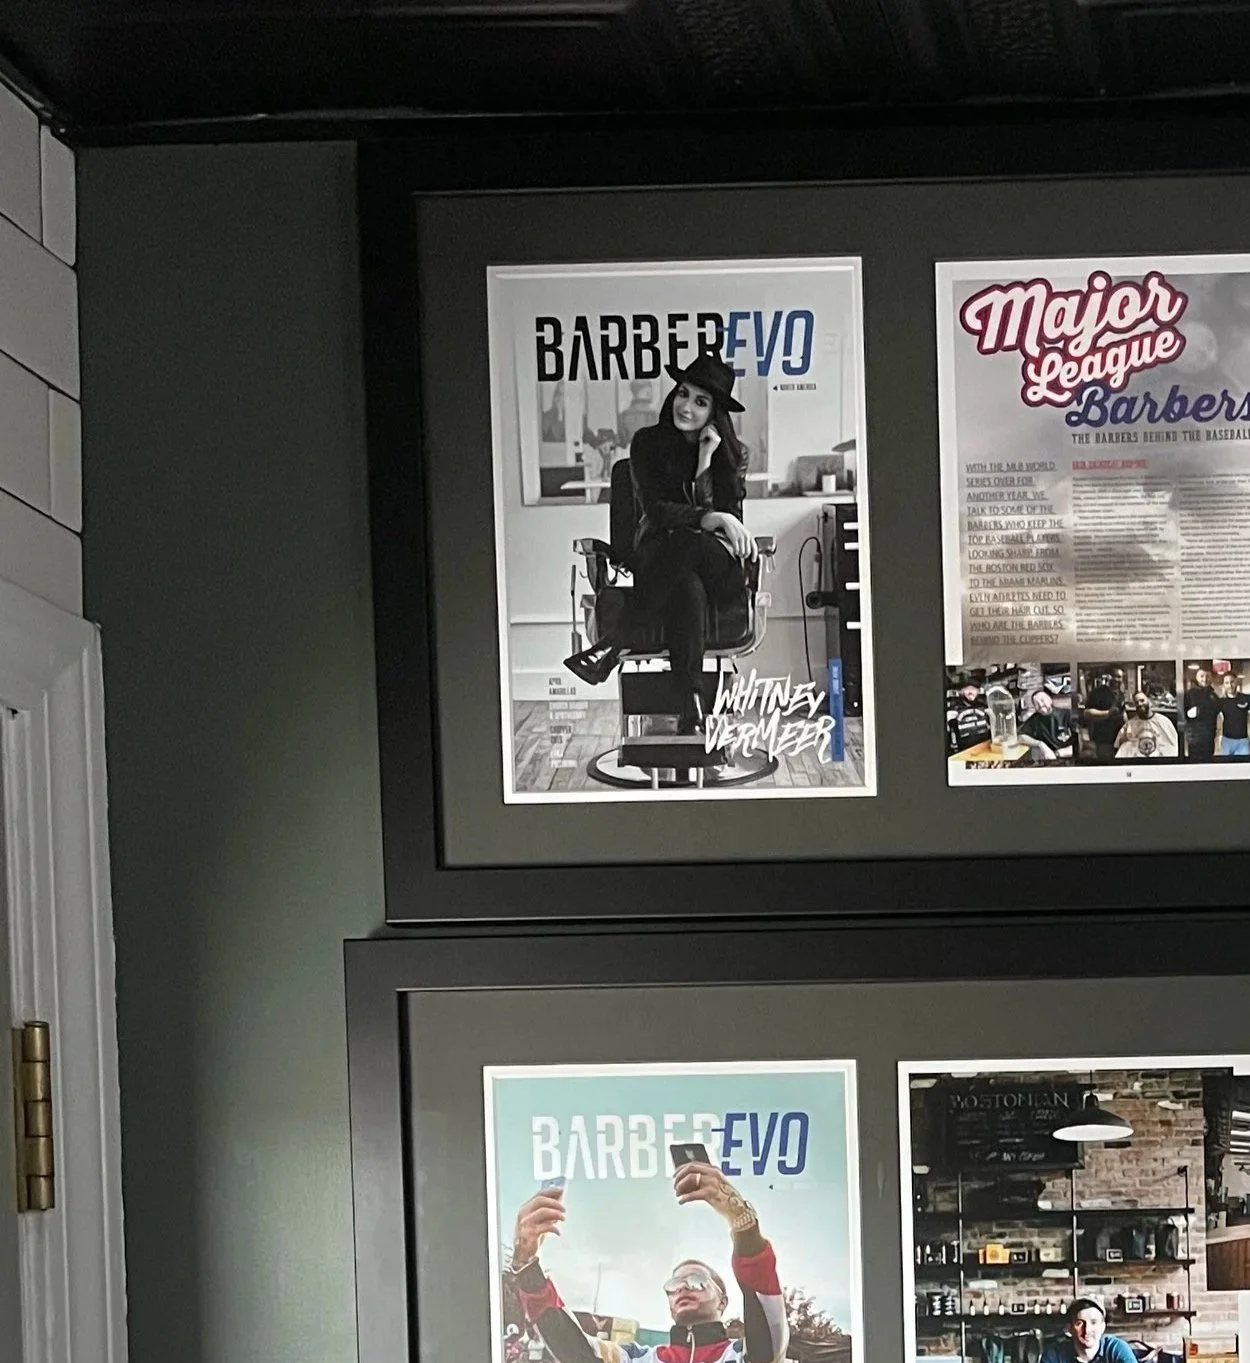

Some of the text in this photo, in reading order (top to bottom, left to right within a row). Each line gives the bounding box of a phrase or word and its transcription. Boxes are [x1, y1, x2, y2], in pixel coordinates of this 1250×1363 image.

[961, 271, 1188, 357] Major
[1021, 328, 1186, 407] League
[1072, 433, 1090, 444] THE
[1095, 432, 1138, 444] BARBERS
[1143, 430, 1177, 443] BEHIND
[1182, 430, 1201, 442] THE
[713, 668, 825, 719] WHITNEY
[705, 708, 836, 764] VERMEER
